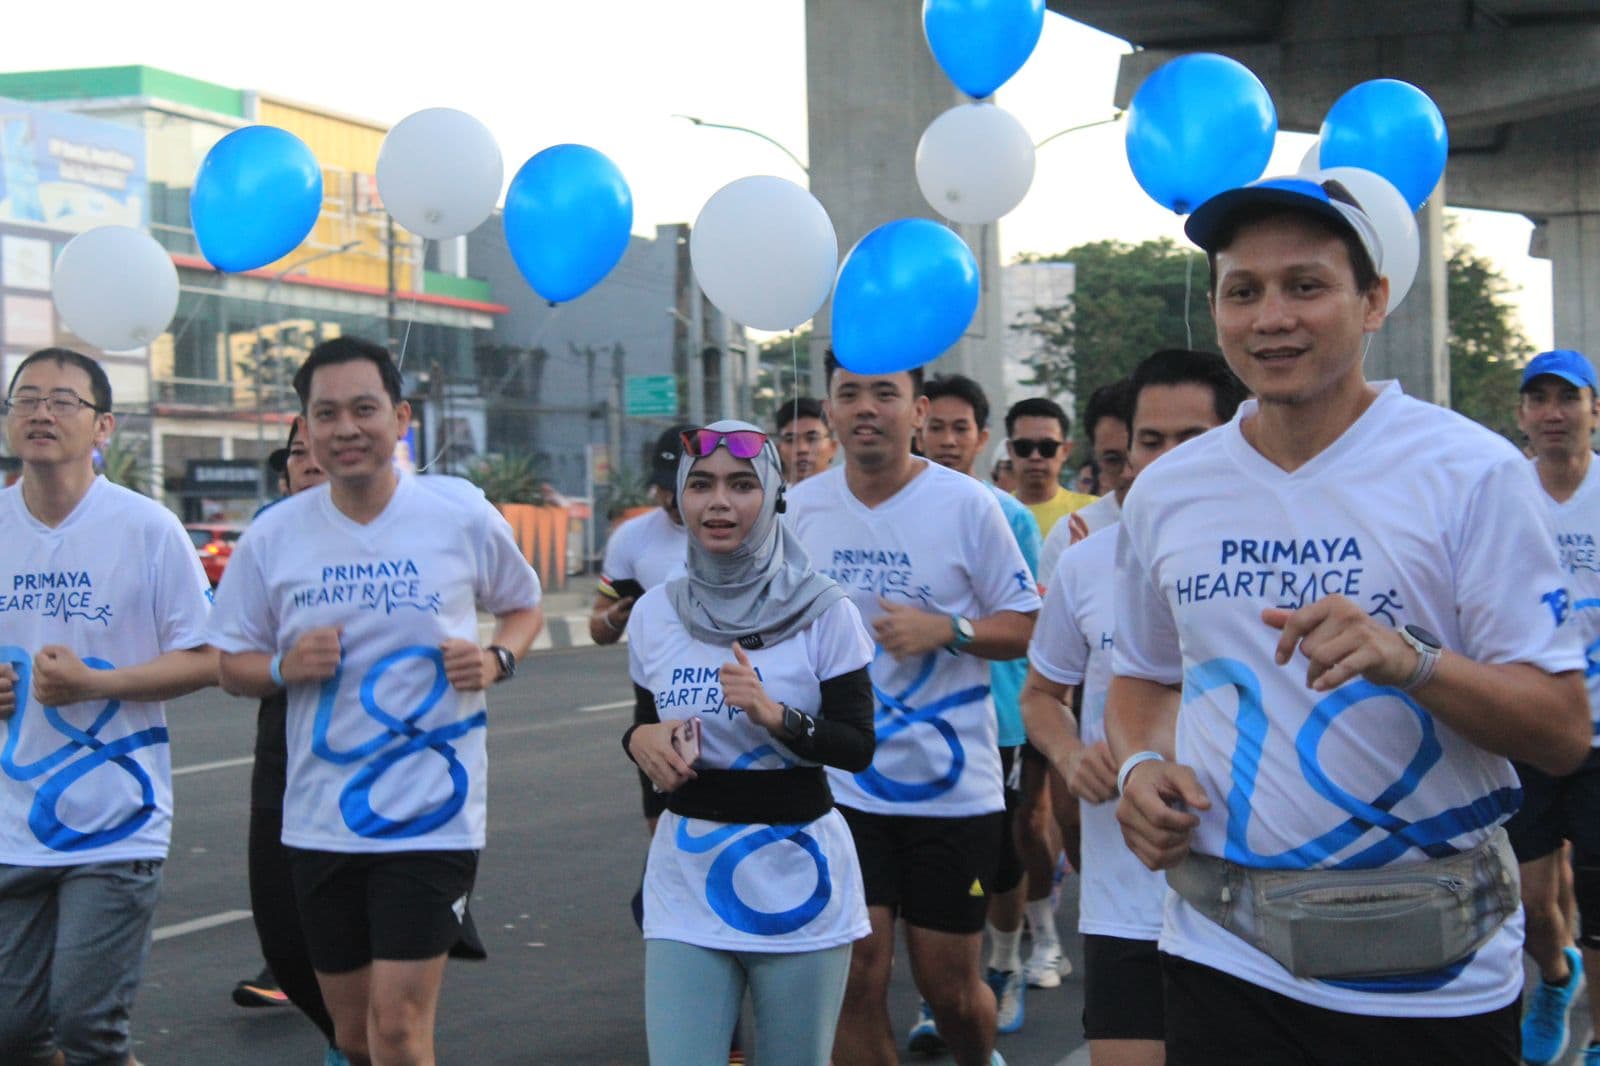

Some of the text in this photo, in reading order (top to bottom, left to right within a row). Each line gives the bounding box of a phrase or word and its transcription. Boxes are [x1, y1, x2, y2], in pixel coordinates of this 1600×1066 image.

[832, 549, 912, 568] PRIMAYA
[1221, 537, 1363, 565] PRIMAYA
[13, 571, 92, 591] PRIMAYA
[322, 558, 420, 583] PRIMAYA
[1176, 571, 1275, 605] HEART
[0, 592, 43, 612] EART
[671, 666, 764, 686] PRIMA
[656, 687, 703, 709] EART
